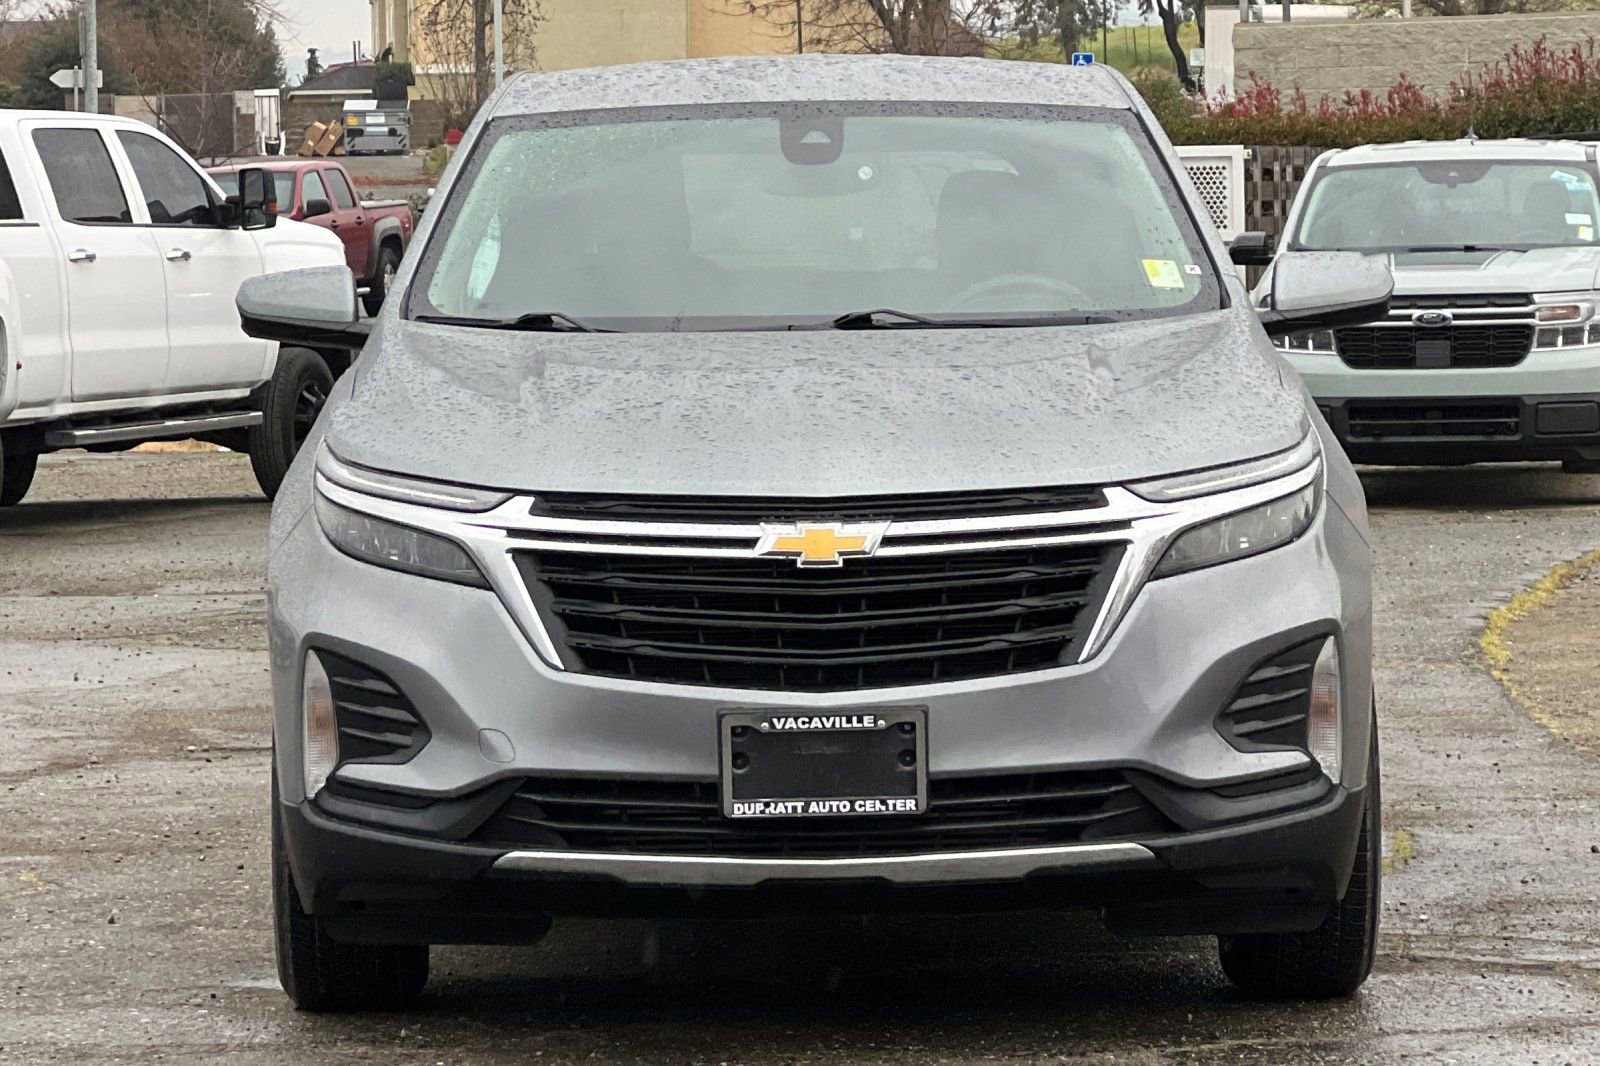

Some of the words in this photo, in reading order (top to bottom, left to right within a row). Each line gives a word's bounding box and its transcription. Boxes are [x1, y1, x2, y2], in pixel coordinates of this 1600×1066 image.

[771, 715, 875, 730] VACAVILLE
[733, 801, 805, 816] DUPRATT
[808, 800, 851, 814] AUTO
[854, 799, 917, 812] CENTER
